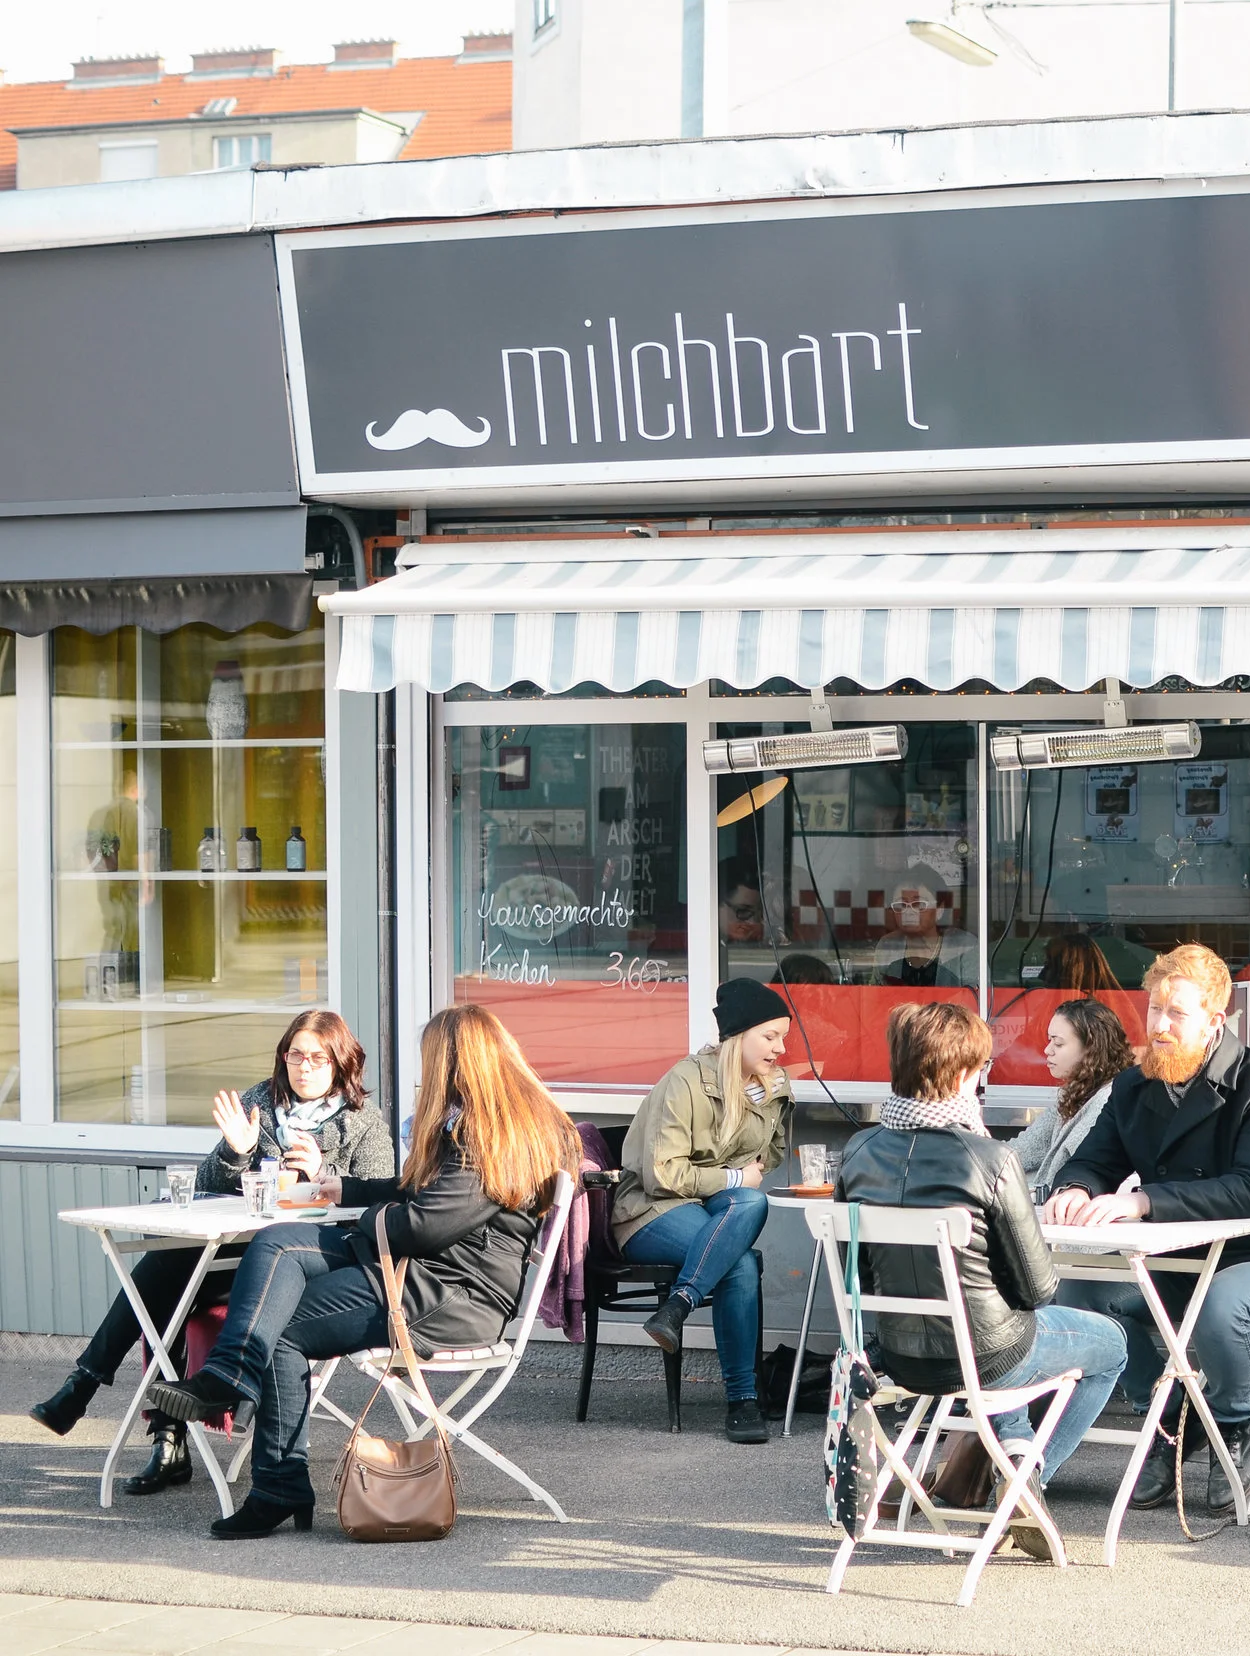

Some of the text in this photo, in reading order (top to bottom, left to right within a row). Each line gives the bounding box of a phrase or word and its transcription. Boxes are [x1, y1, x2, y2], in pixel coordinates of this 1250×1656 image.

[501, 303, 929, 446] milchbart
[600, 746, 669, 773] THEATER
[624, 784, 649, 809] AM
[607, 817, 663, 846] ARSCH
[620, 855, 652, 882] DER
[479, 941, 556, 987] Kuchen
